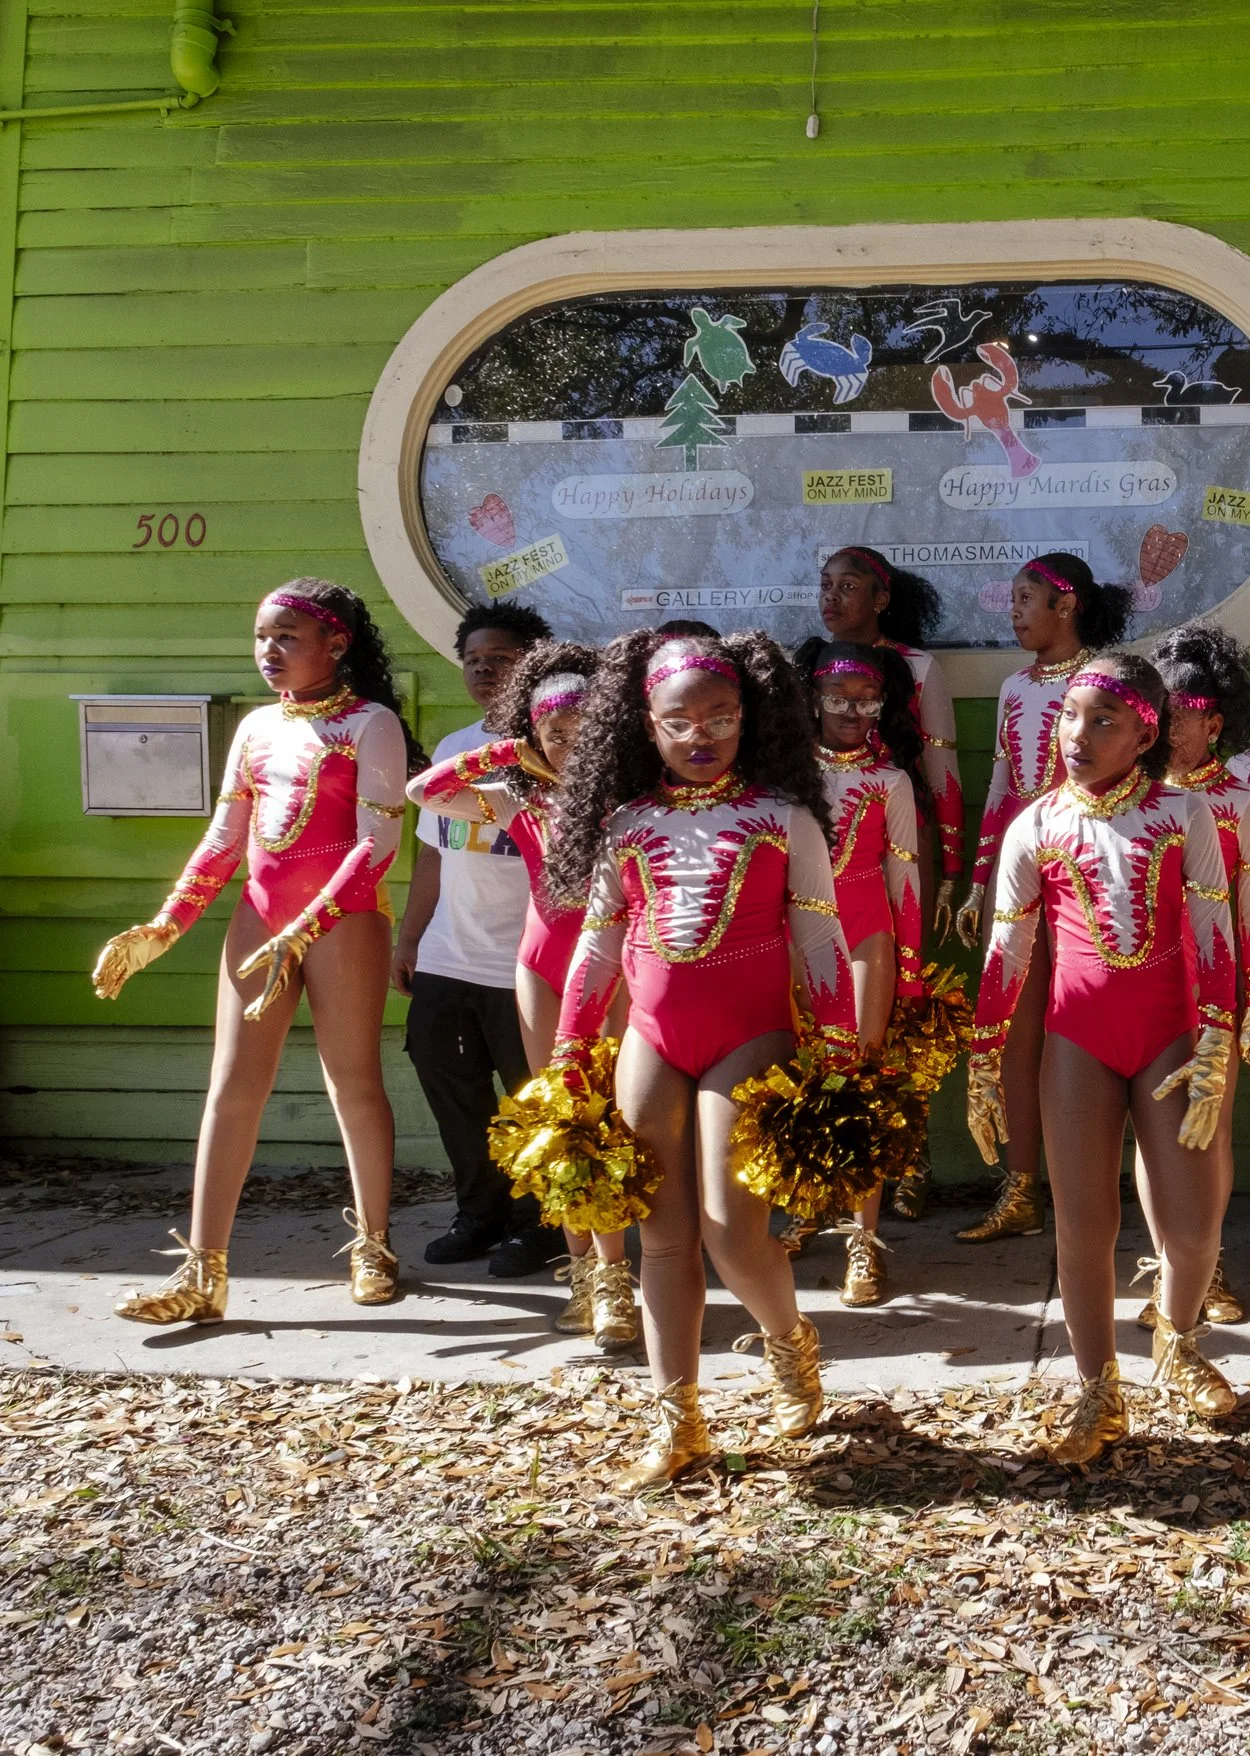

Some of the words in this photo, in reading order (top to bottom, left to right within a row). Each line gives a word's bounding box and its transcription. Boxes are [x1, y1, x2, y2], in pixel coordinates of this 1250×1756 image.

[807, 475, 844, 487] JAZZ
[848, 474, 885, 486] FEST
[807, 488, 827, 499] ON
[831, 488, 850, 498] MY
[855, 486, 887, 498] MIND
[943, 472, 1020, 506] Happy
[1028, 470, 1110, 495] Mardis
[1119, 473, 1171, 498] Gras
[558, 481, 635, 514] Happy
[645, 477, 748, 510] Holidays
[1208, 492, 1246, 508] JAZZ
[1207, 505, 1226, 517] ON
[1231, 508, 1250, 519] MY
[132, 513, 206, 548] 500
[487, 559, 520, 582] JAZZ
[522, 542, 555, 565] FEST
[889, 544, 1039, 562] THOMASMANN
[490, 579, 510, 592] ON
[512, 569, 529, 584] MY
[532, 552, 563, 574] MIND
[656, 590, 752, 607] GALLERY
[758, 587, 784, 604] I/O
[787, 592, 814, 600] SHOP
[438, 815, 521, 857] NOLA
